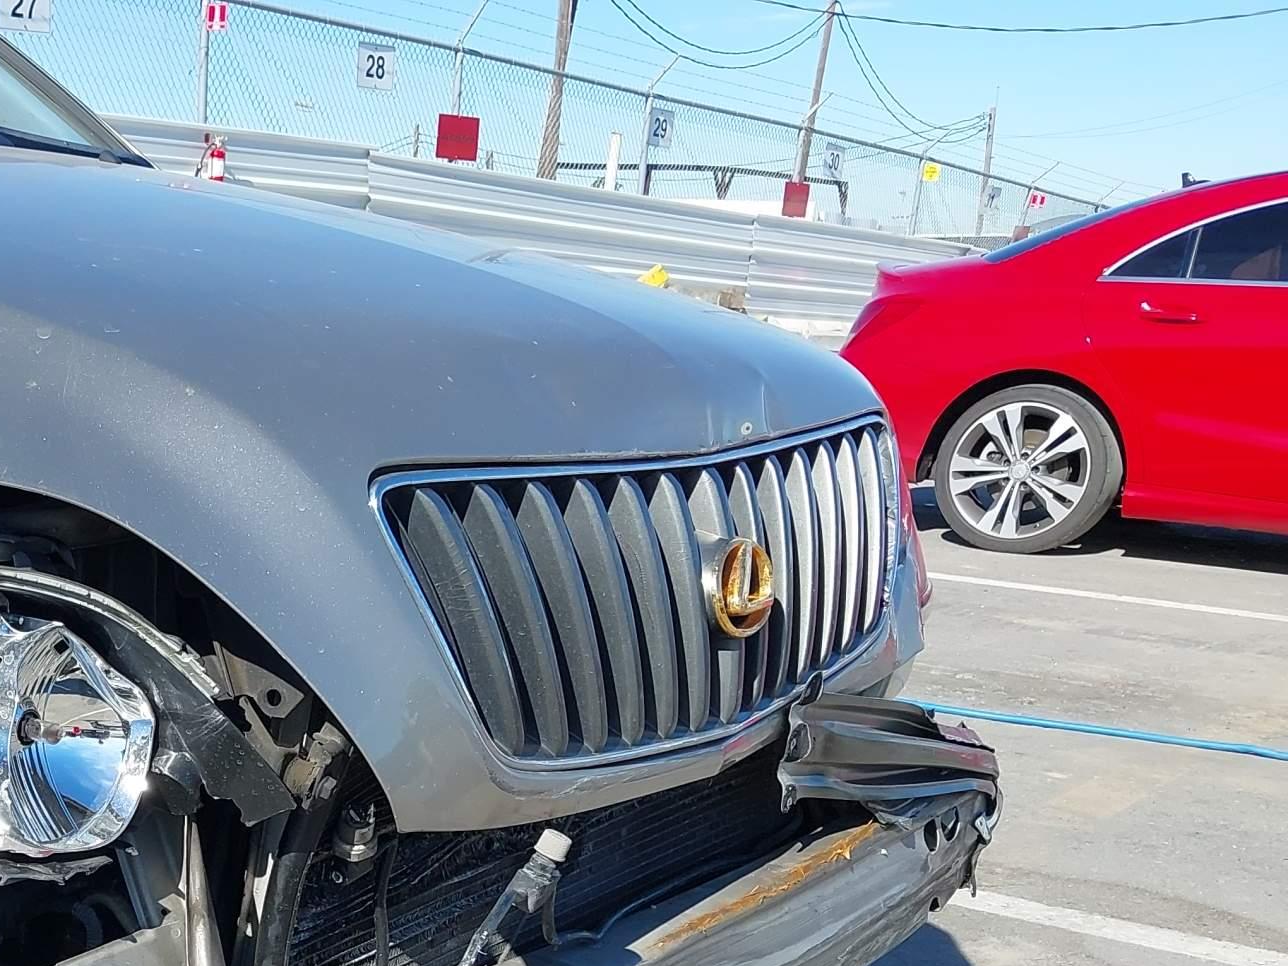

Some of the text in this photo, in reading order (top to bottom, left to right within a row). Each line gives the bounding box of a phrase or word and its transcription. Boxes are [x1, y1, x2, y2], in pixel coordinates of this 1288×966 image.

[365, 54, 385, 80] 28
[653, 117, 668, 139] 29
[828, 152, 840, 171] 30
